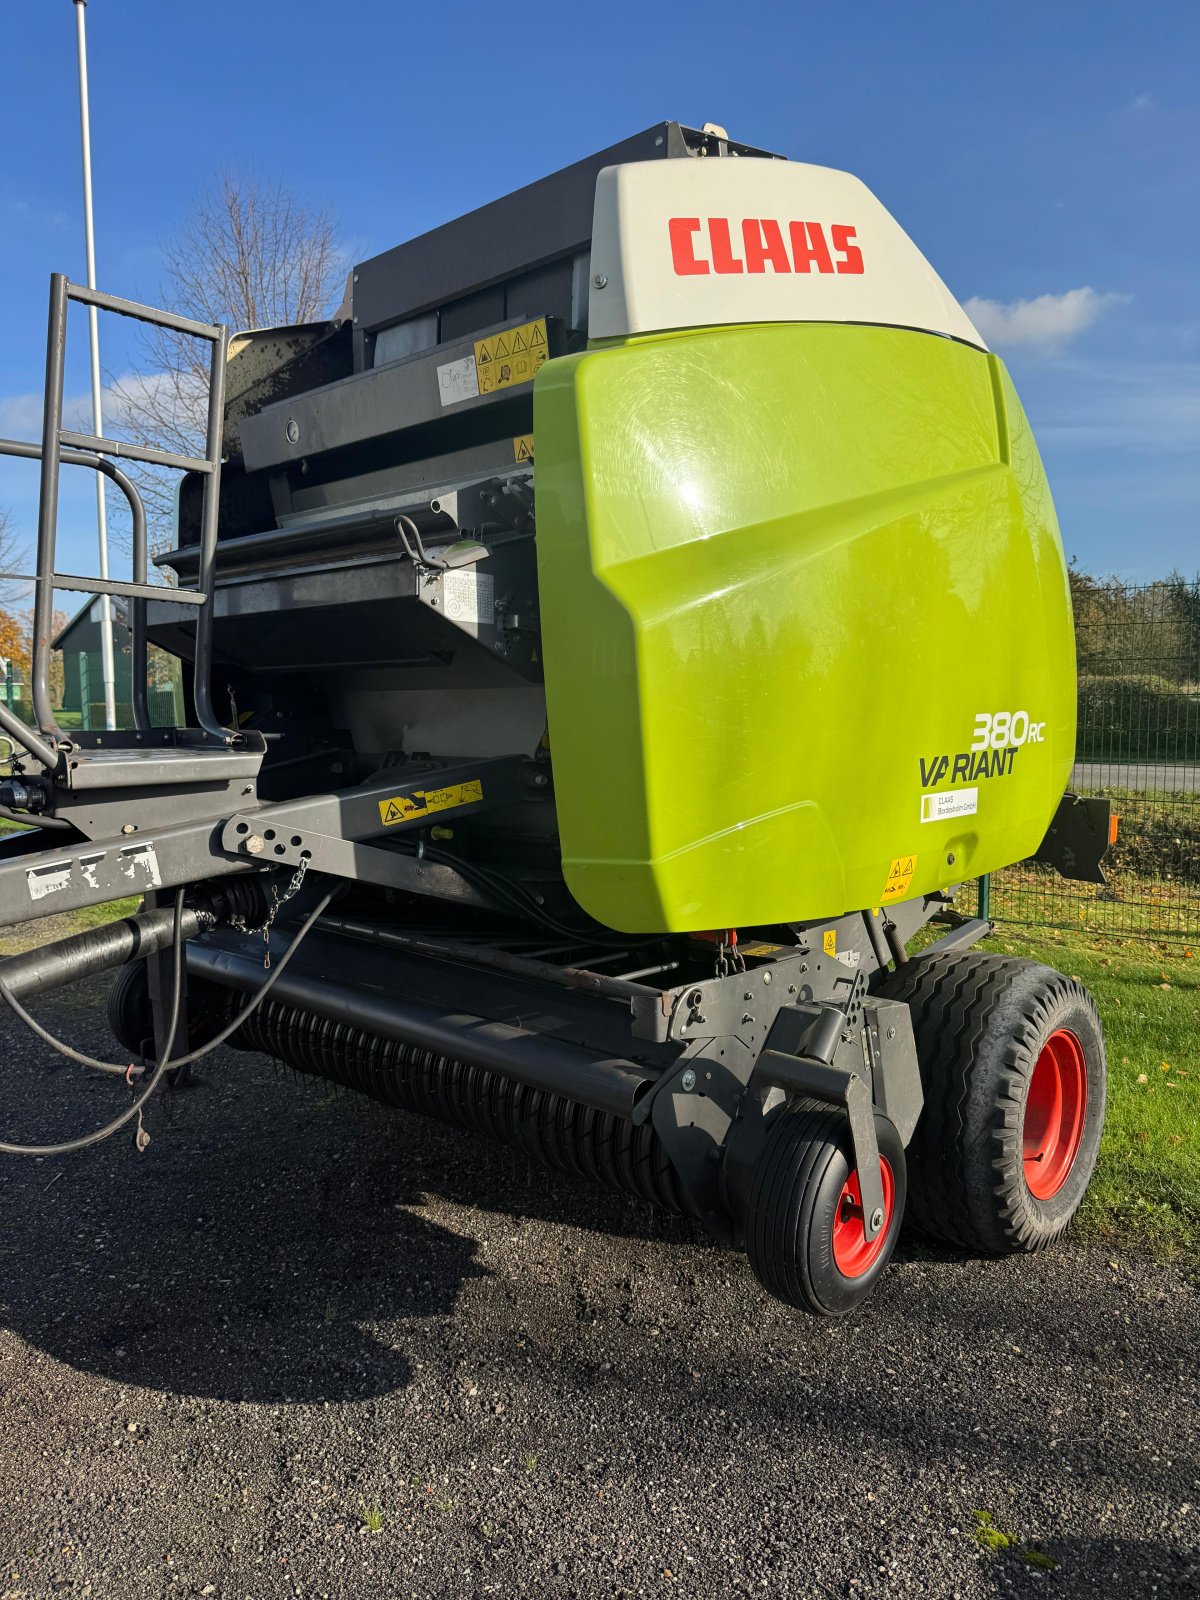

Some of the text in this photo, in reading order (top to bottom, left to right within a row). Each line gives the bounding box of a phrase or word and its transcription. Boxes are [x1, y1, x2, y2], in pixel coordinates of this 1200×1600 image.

[668, 217, 865, 276] CLAAS
[919, 747, 1019, 788] VARIANT
[938, 795, 954, 805] CLAAS
